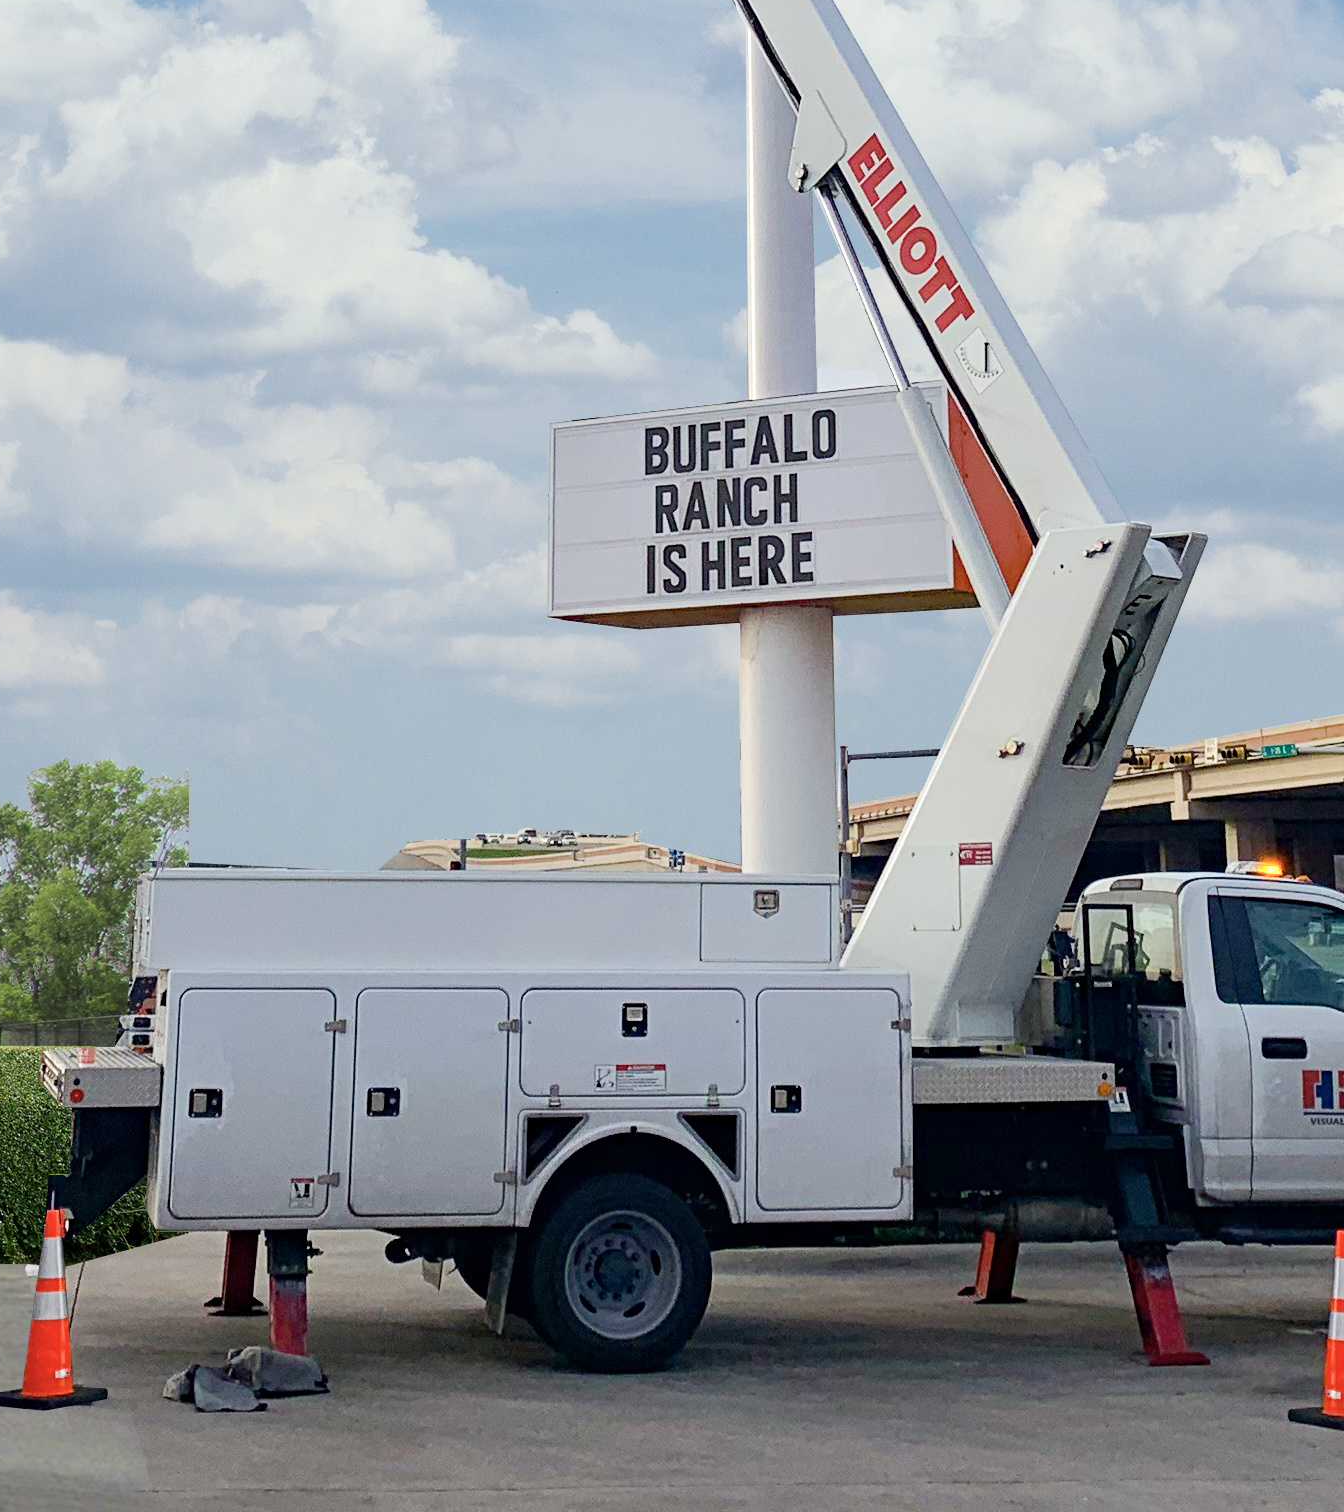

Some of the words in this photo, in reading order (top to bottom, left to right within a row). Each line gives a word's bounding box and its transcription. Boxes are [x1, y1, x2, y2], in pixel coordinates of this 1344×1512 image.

[847, 132, 976, 334] ELLIOTT
[644, 408, 837, 476] BUFFALO
[655, 472, 799, 534] RANCH
[646, 543, 687, 594] IS
[701, 530, 814, 590] HERE
[1310, 1117, 1344, 1126] VISUAL
